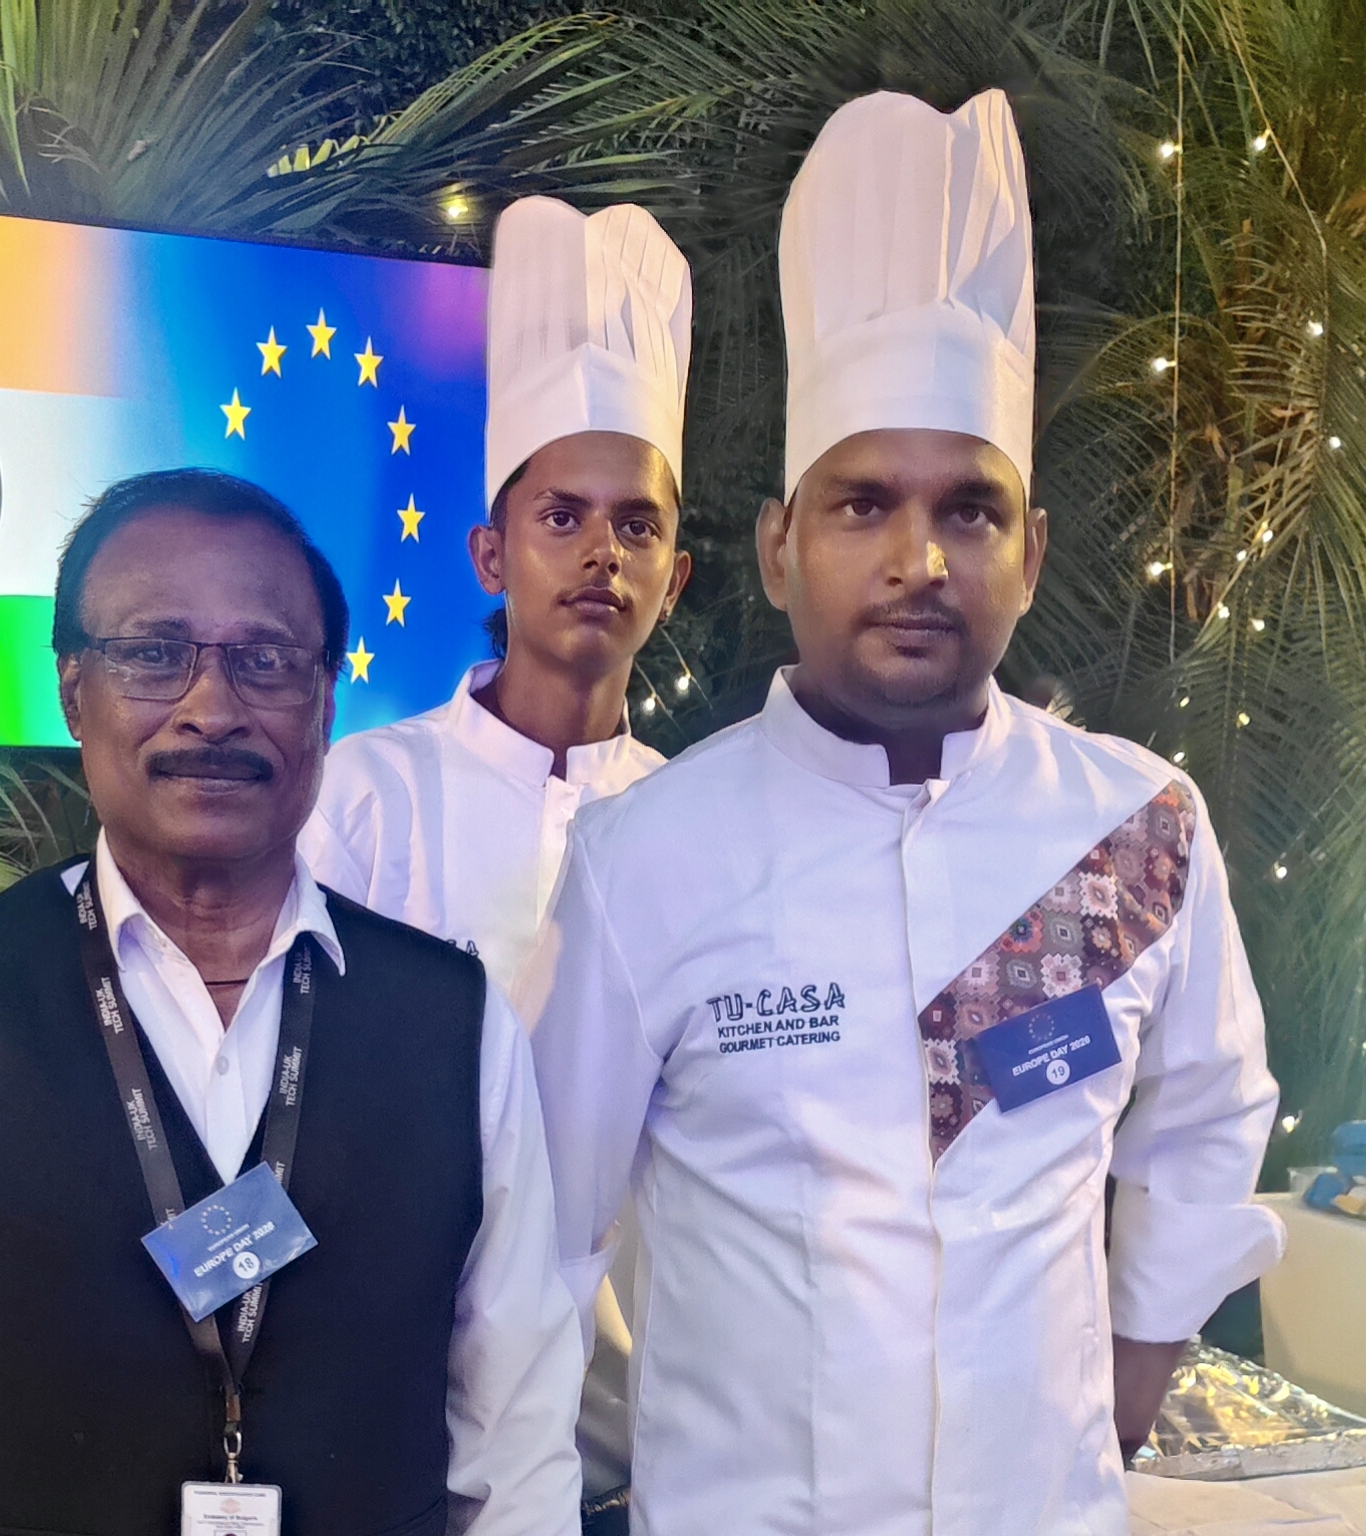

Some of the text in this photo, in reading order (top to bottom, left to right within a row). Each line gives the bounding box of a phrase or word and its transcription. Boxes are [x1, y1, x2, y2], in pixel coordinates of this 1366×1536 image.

[101, 977, 124, 1035] TECH SUMMIT
[706, 982, 845, 1022] TU-CASA
[718, 1015, 839, 1038] KITCHEN AND BAR
[719, 1031, 840, 1053] GOURMET CATERING
[279, 1054, 293, 1095] INDIA-UK
[286, 1046, 303, 1107] TECH SUMMIT
[1012, 1053, 1050, 1077] EUROPE
[1050, 1045, 1068, 1059] DAY
[1051, 1066, 1065, 1079] 19
[132, 1088, 158, 1151] TECH SUMMIT
[194, 1247, 235, 1278] EUROPE
[234, 1235, 253, 1253] DAY
[238, 1257, 254, 1273] 18
[242, 1318, 256, 1344] TECH
